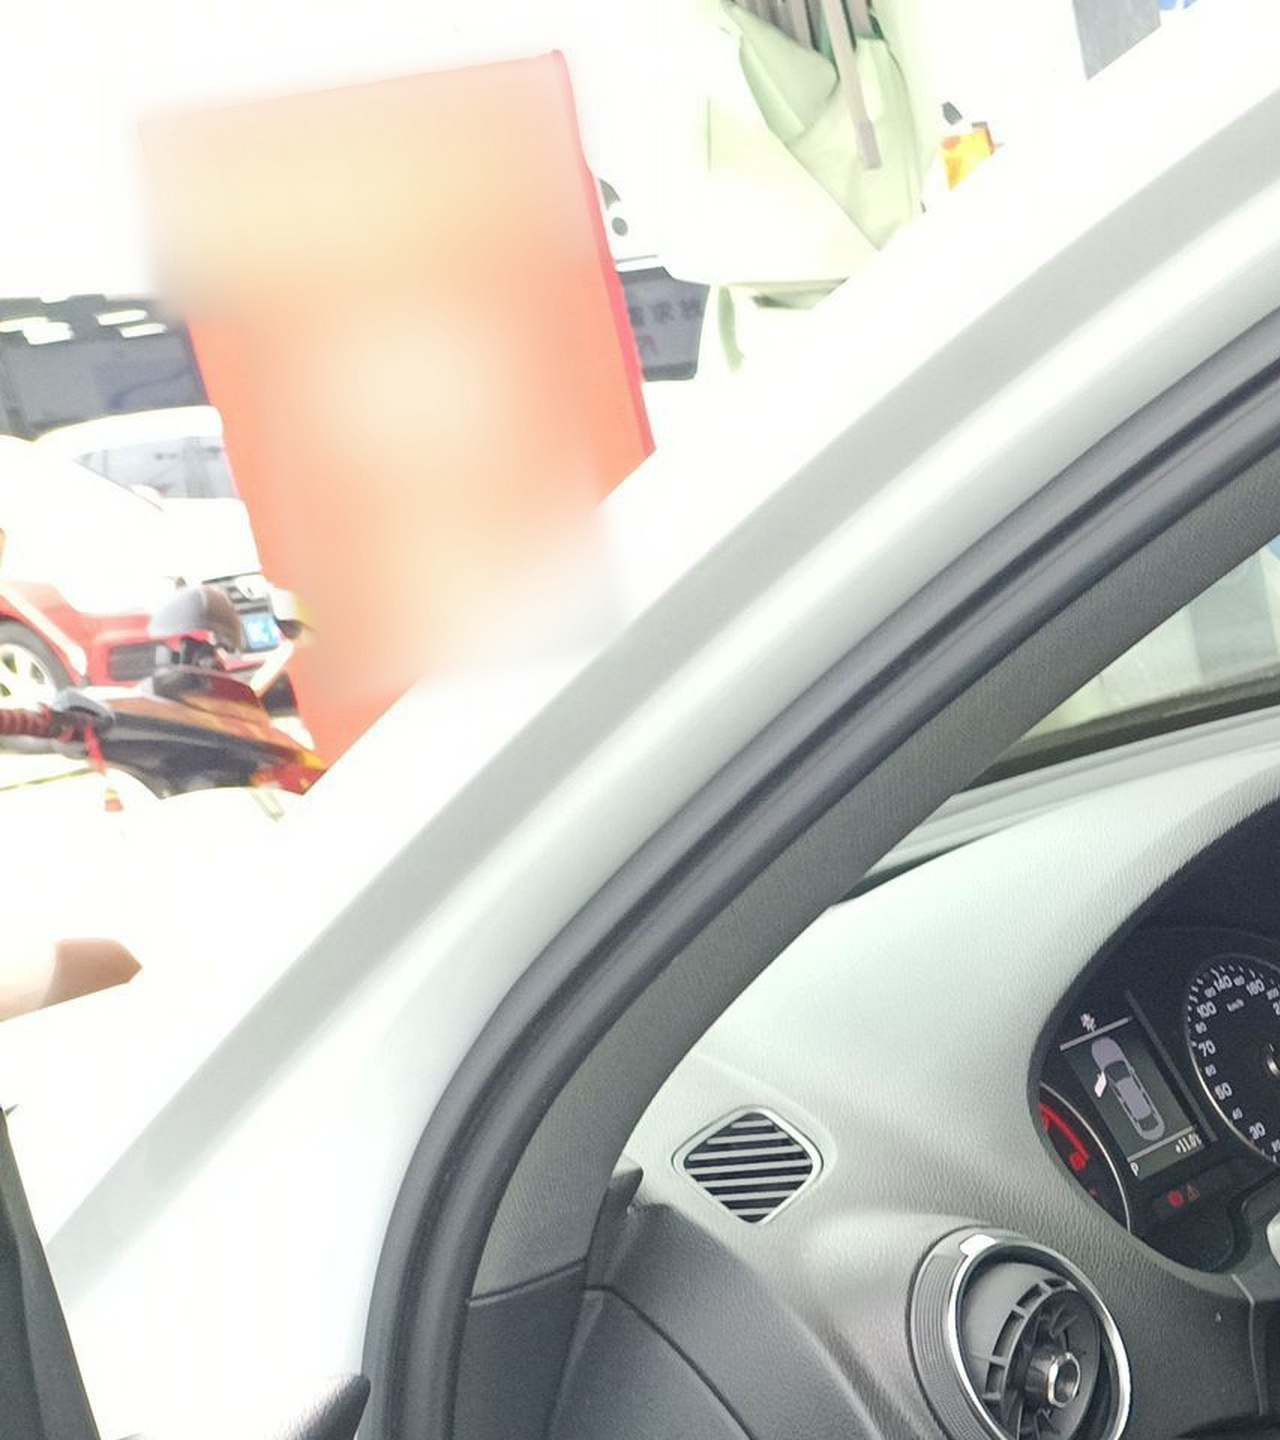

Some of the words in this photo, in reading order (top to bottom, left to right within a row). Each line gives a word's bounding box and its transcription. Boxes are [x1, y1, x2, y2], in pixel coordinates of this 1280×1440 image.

[1196, 1001, 1217, 1018] 100
[1198, 1040, 1216, 1057] 70
[1214, 1082, 1232, 1100] 50
[1249, 1122, 1266, 1140] 30
[1130, 1162, 1139, 1176] P
